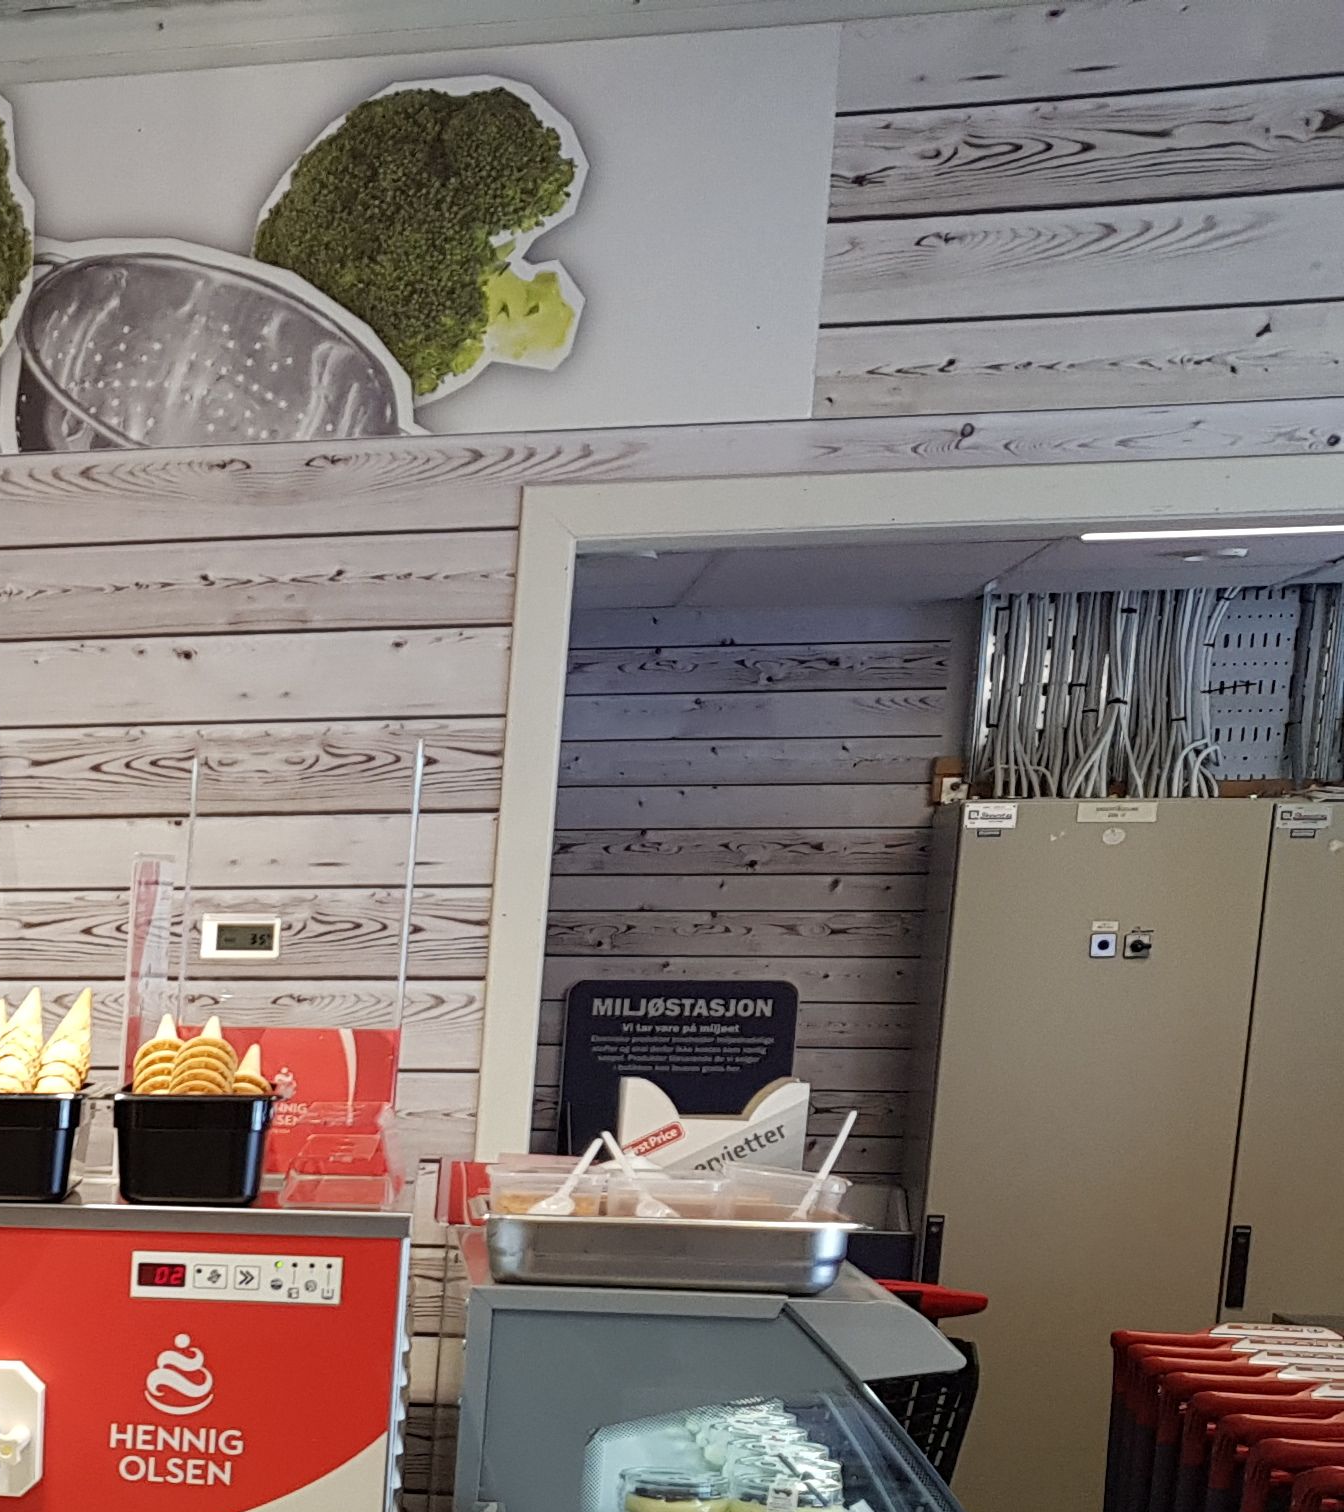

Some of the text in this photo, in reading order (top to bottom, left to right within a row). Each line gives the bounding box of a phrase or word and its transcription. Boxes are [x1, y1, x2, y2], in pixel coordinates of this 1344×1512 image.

[592, 997, 774, 1018] MILJØSTASJON
[622, 1023, 633, 1032] Vi
[649, 1128, 678, 1147] Price
[110, 1424, 244, 1456] HENNIG
[118, 1456, 232, 1486] OLSEN
